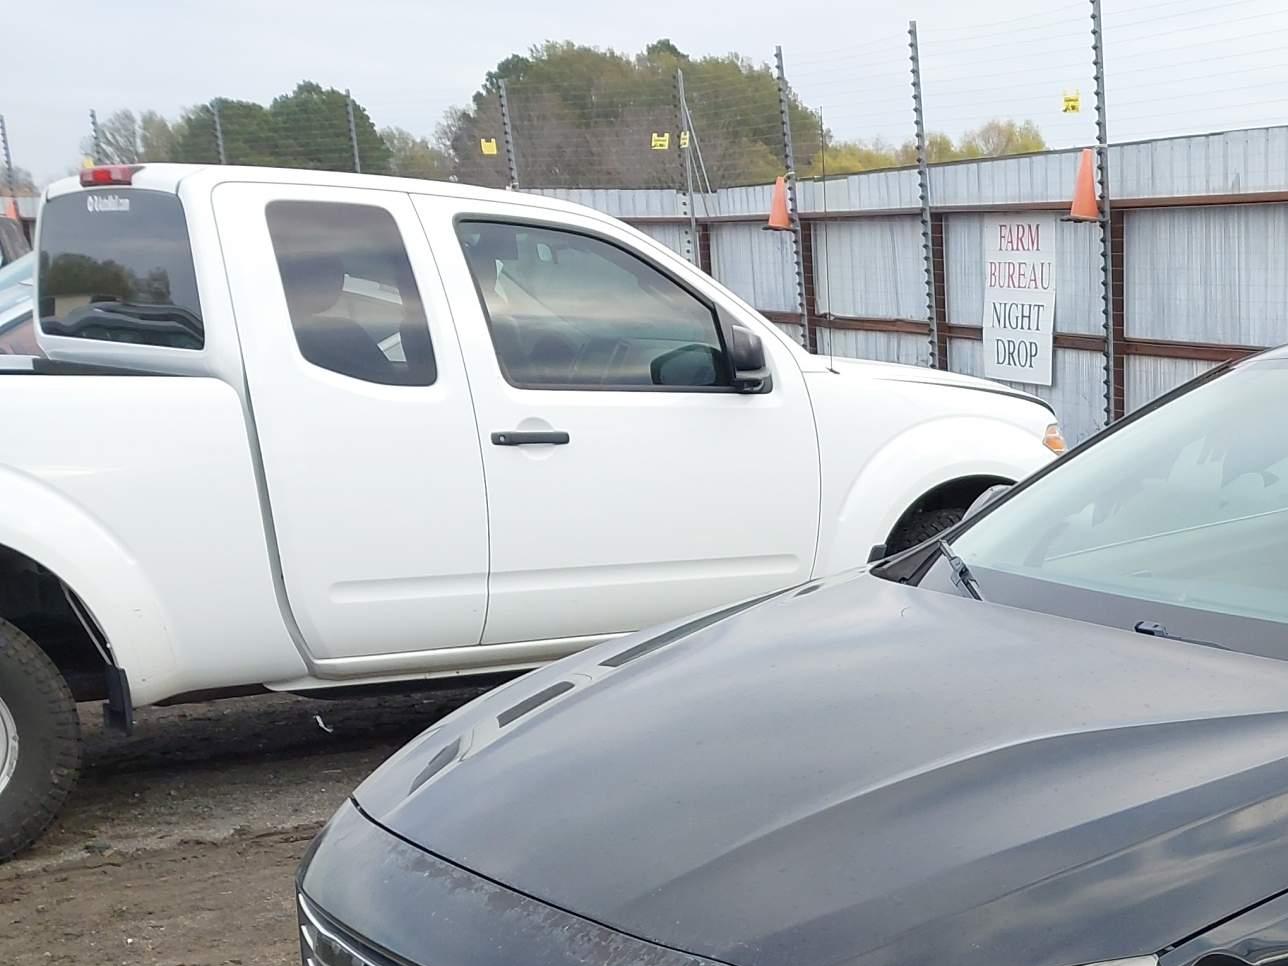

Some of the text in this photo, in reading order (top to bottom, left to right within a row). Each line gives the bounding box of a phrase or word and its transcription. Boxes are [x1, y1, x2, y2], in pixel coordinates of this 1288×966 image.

[998, 223, 1041, 252] FARM
[989, 261, 1051, 290] BUREAU
[991, 301, 1045, 331] NIGHT
[995, 338, 1038, 369] DROP
